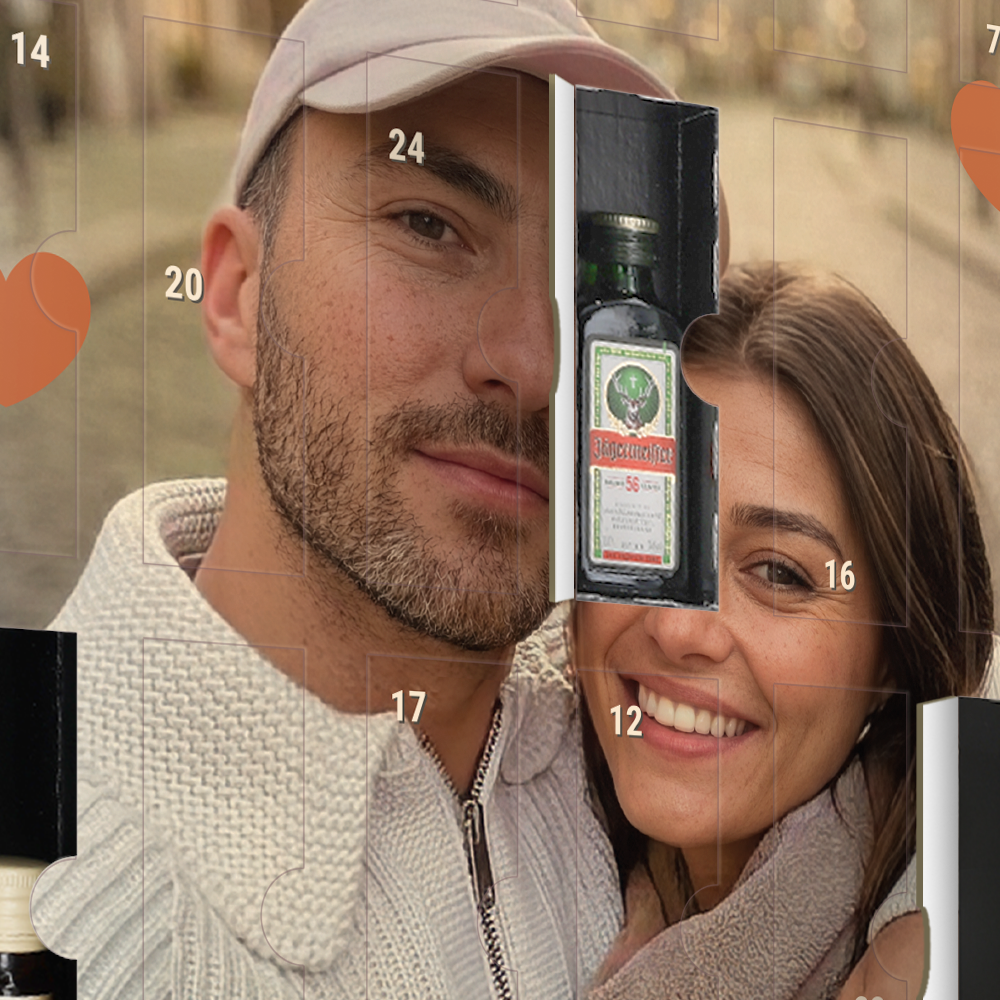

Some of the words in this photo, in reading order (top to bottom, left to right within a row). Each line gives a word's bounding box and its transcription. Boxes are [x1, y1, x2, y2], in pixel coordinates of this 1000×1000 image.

[11, 31, 50, 69] 14
[388, 128, 426, 164] 24
[164, 264, 204, 301] 20
[825, 559, 855, 591] 16
[390, 690, 427, 722] 17
[610, 704, 643, 737] 12
